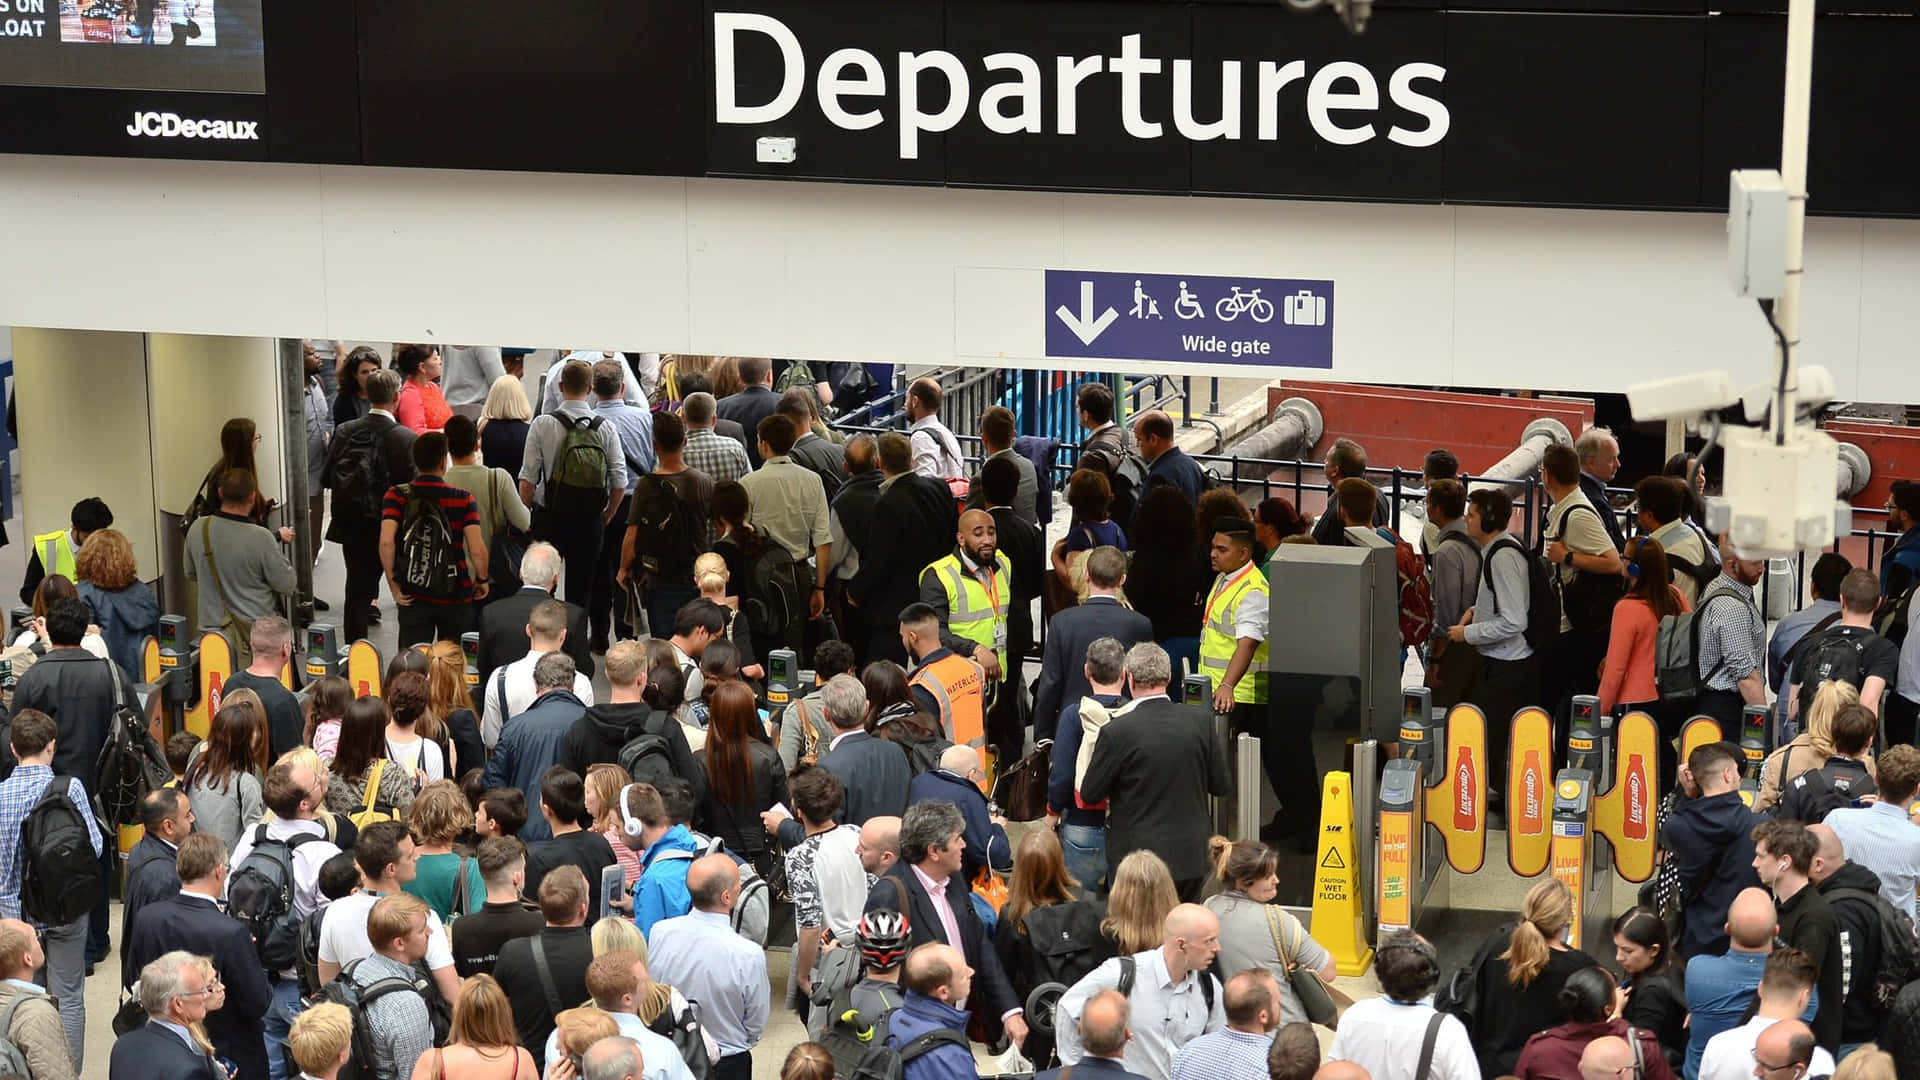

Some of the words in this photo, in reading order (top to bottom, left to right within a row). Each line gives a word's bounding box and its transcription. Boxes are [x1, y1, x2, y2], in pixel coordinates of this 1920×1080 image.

[16, 0, 45, 14] ON
[714, 11, 1451, 160] Departures
[126, 111, 259, 140] JCDecaux
[1182, 334, 1227, 353] Wide
[1231, 338, 1271, 358] gate
[1384, 833, 1406, 844] LIVE
[1384, 850, 1406, 863] FULL
[1320, 877, 1347, 885] CAUTION
[1324, 884, 1342, 892] WET
[1320, 893, 1348, 901] FLOOR
